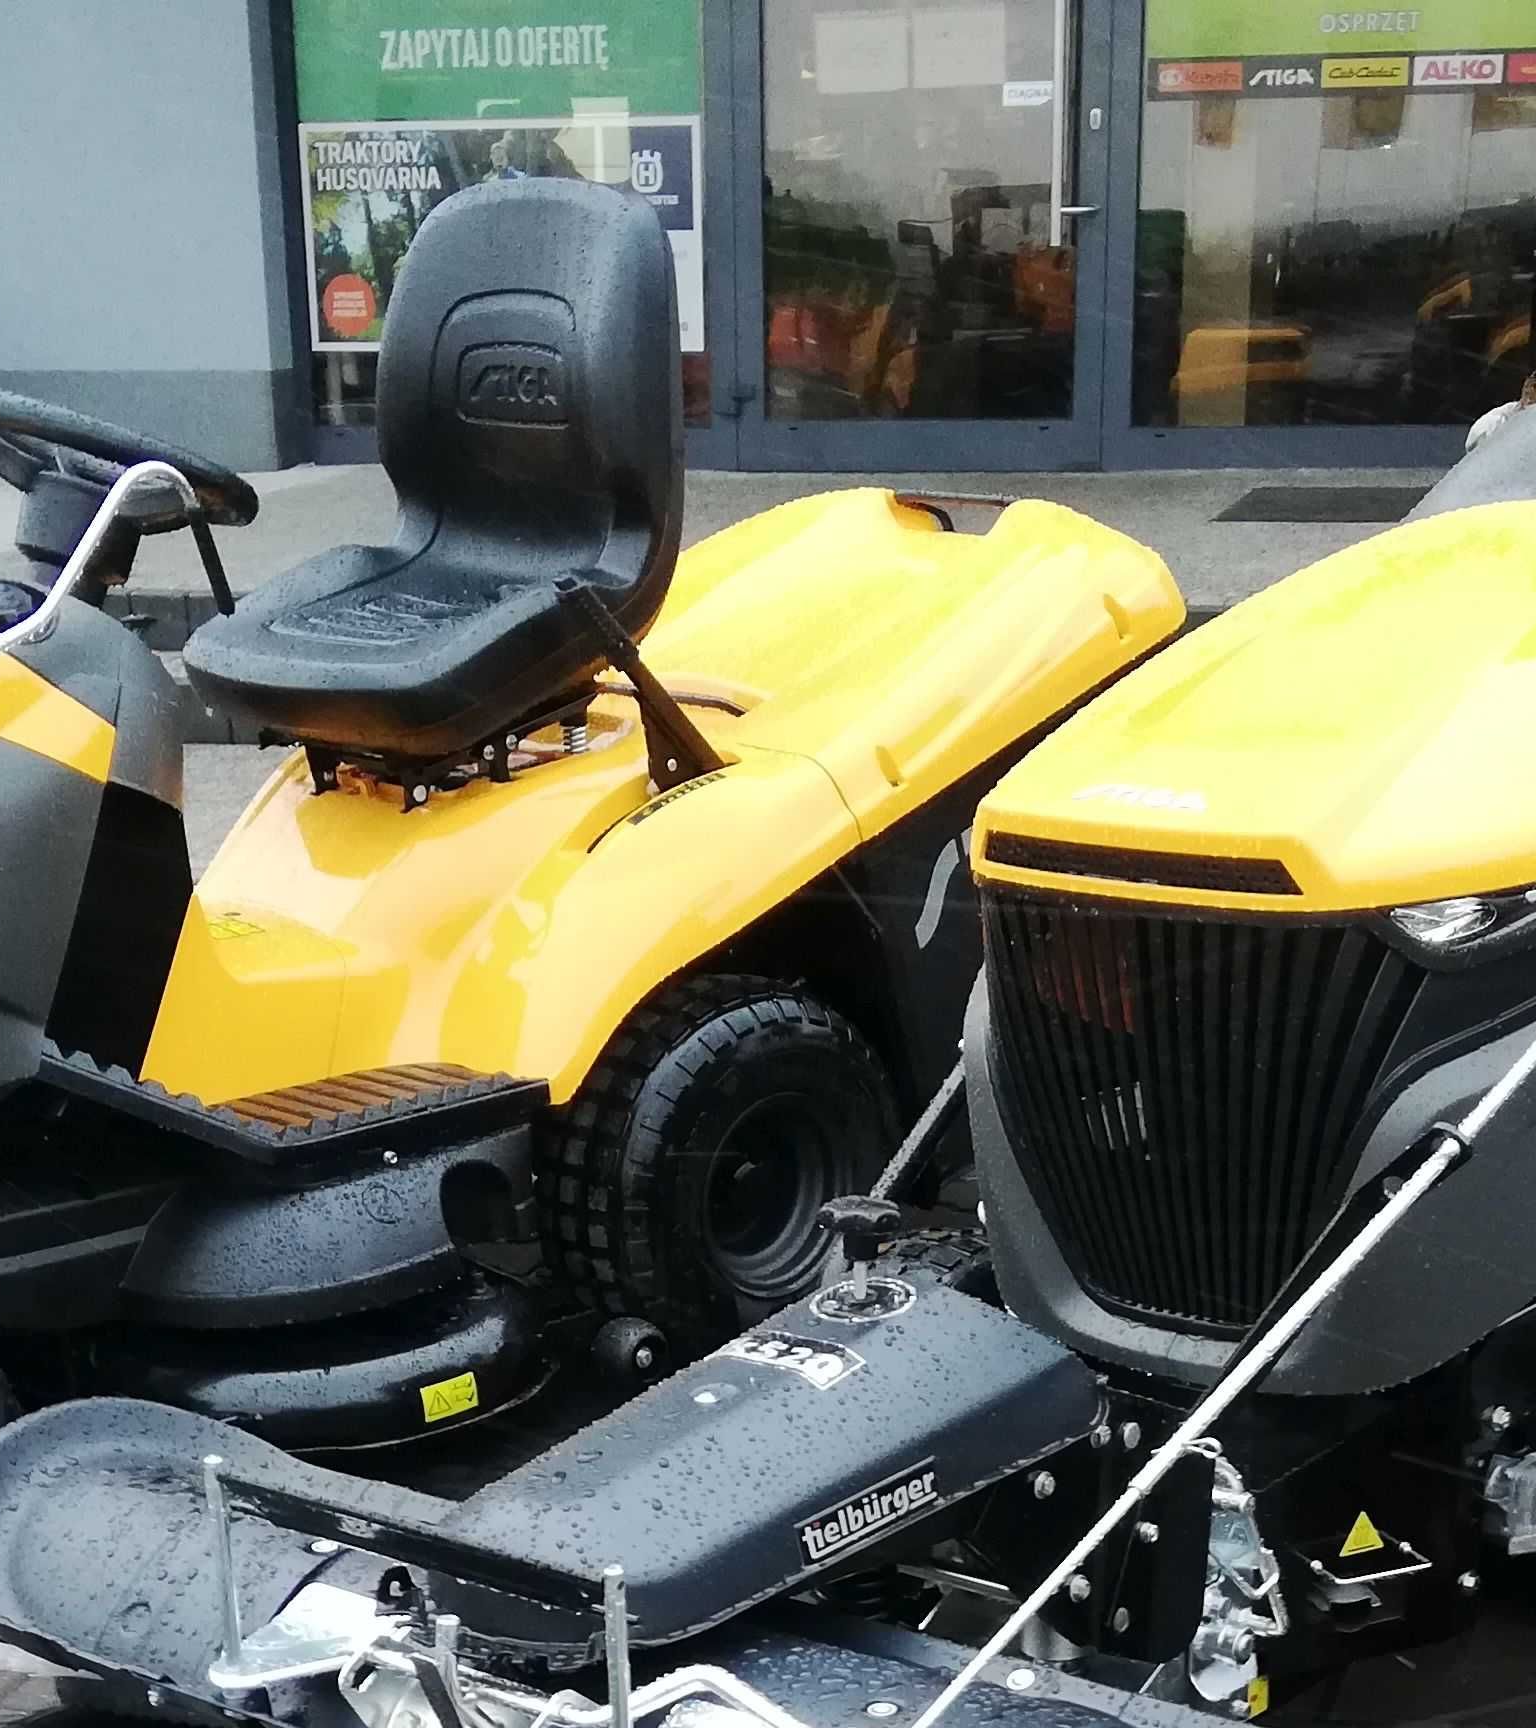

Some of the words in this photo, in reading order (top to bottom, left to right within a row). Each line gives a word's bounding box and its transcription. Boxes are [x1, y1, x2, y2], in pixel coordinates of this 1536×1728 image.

[379, 28, 489, 71] ZAPYTAJ
[496, 27, 513, 67] O
[517, 24, 609, 71] OFERTĘ
[1249, 68, 1314, 87] STIGA
[1421, 59, 1496, 81] AL-KO
[314, 140, 421, 165] TRAKTORY
[316, 166, 442, 191] HUSQVARNA
[802, 1471, 936, 1556] tielbürger
